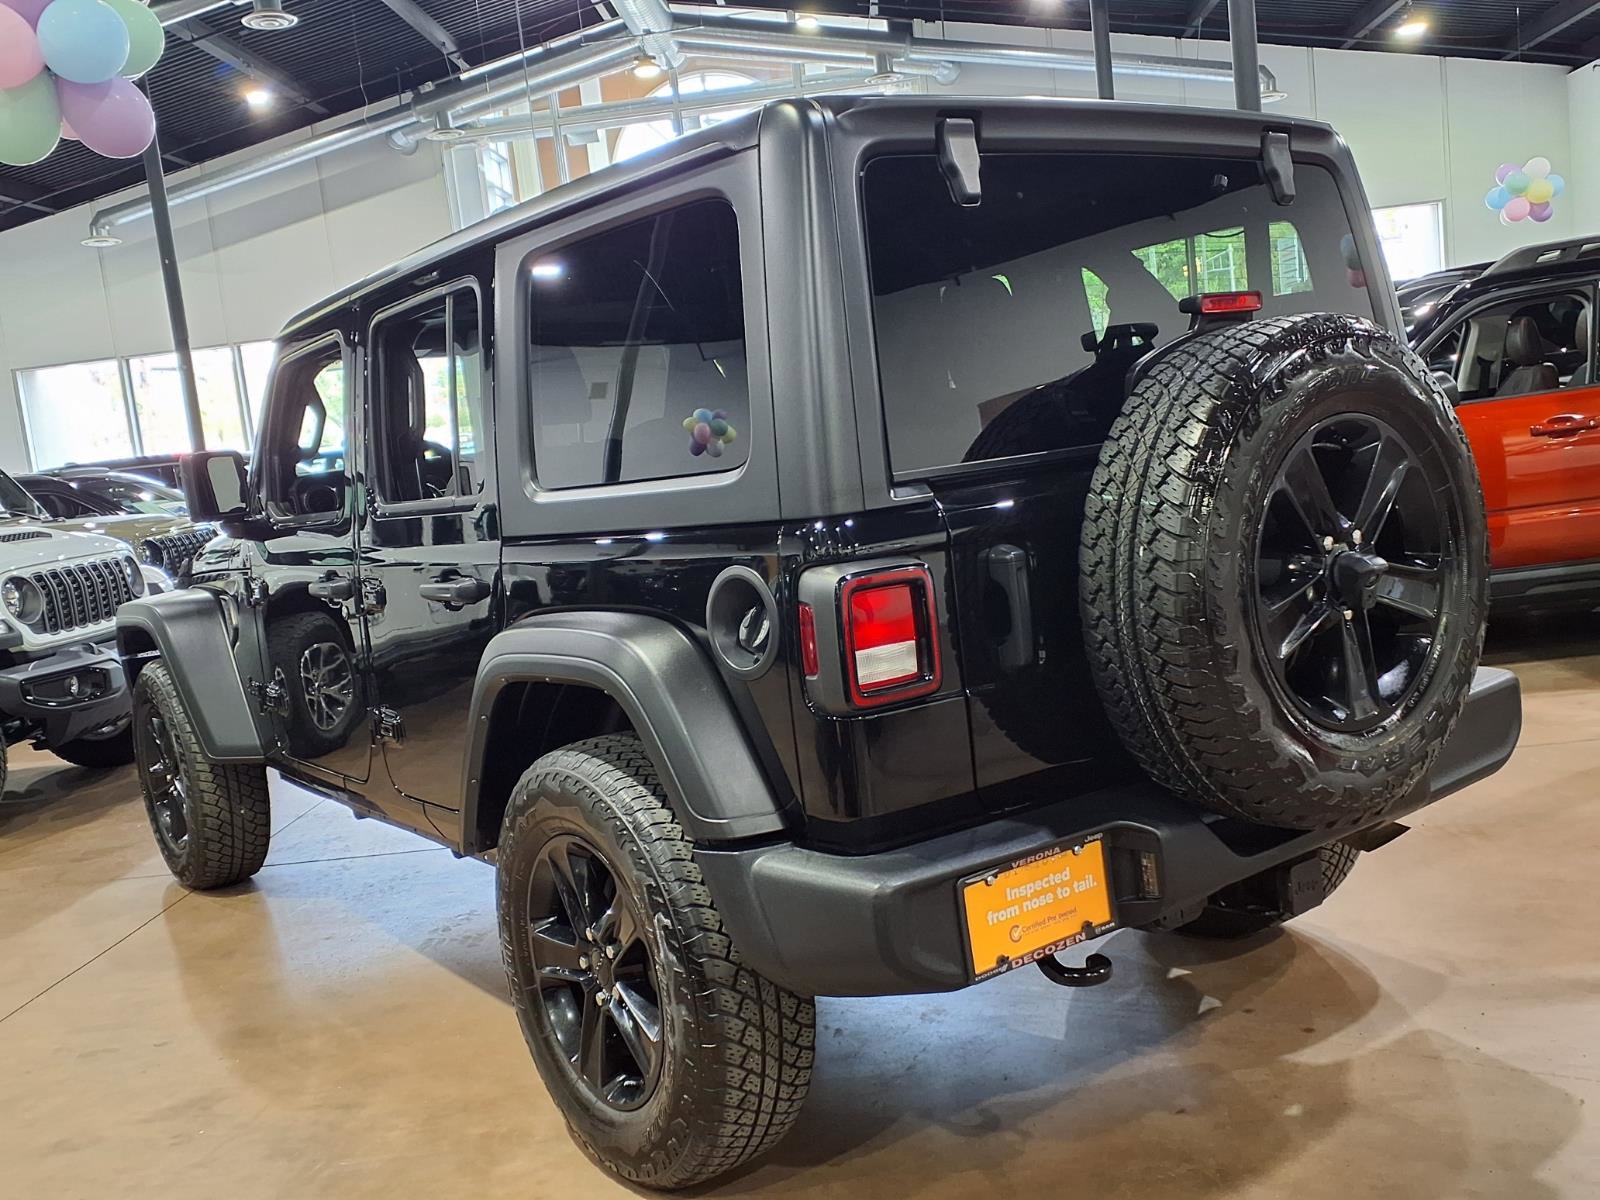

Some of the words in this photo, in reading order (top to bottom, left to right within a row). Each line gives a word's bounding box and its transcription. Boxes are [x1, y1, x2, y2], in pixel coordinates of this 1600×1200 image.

[1084, 832, 1103, 842] Jeep
[1011, 846, 1060, 869] VERONA
[987, 905, 1019, 926] from
[1022, 892, 1054, 912] nose
[1056, 885, 1070, 899] to
[1073, 874, 1097, 894] tail.
[1006, 867, 1071, 901] Inspected
[1011, 932, 1087, 968] DECOZEN
